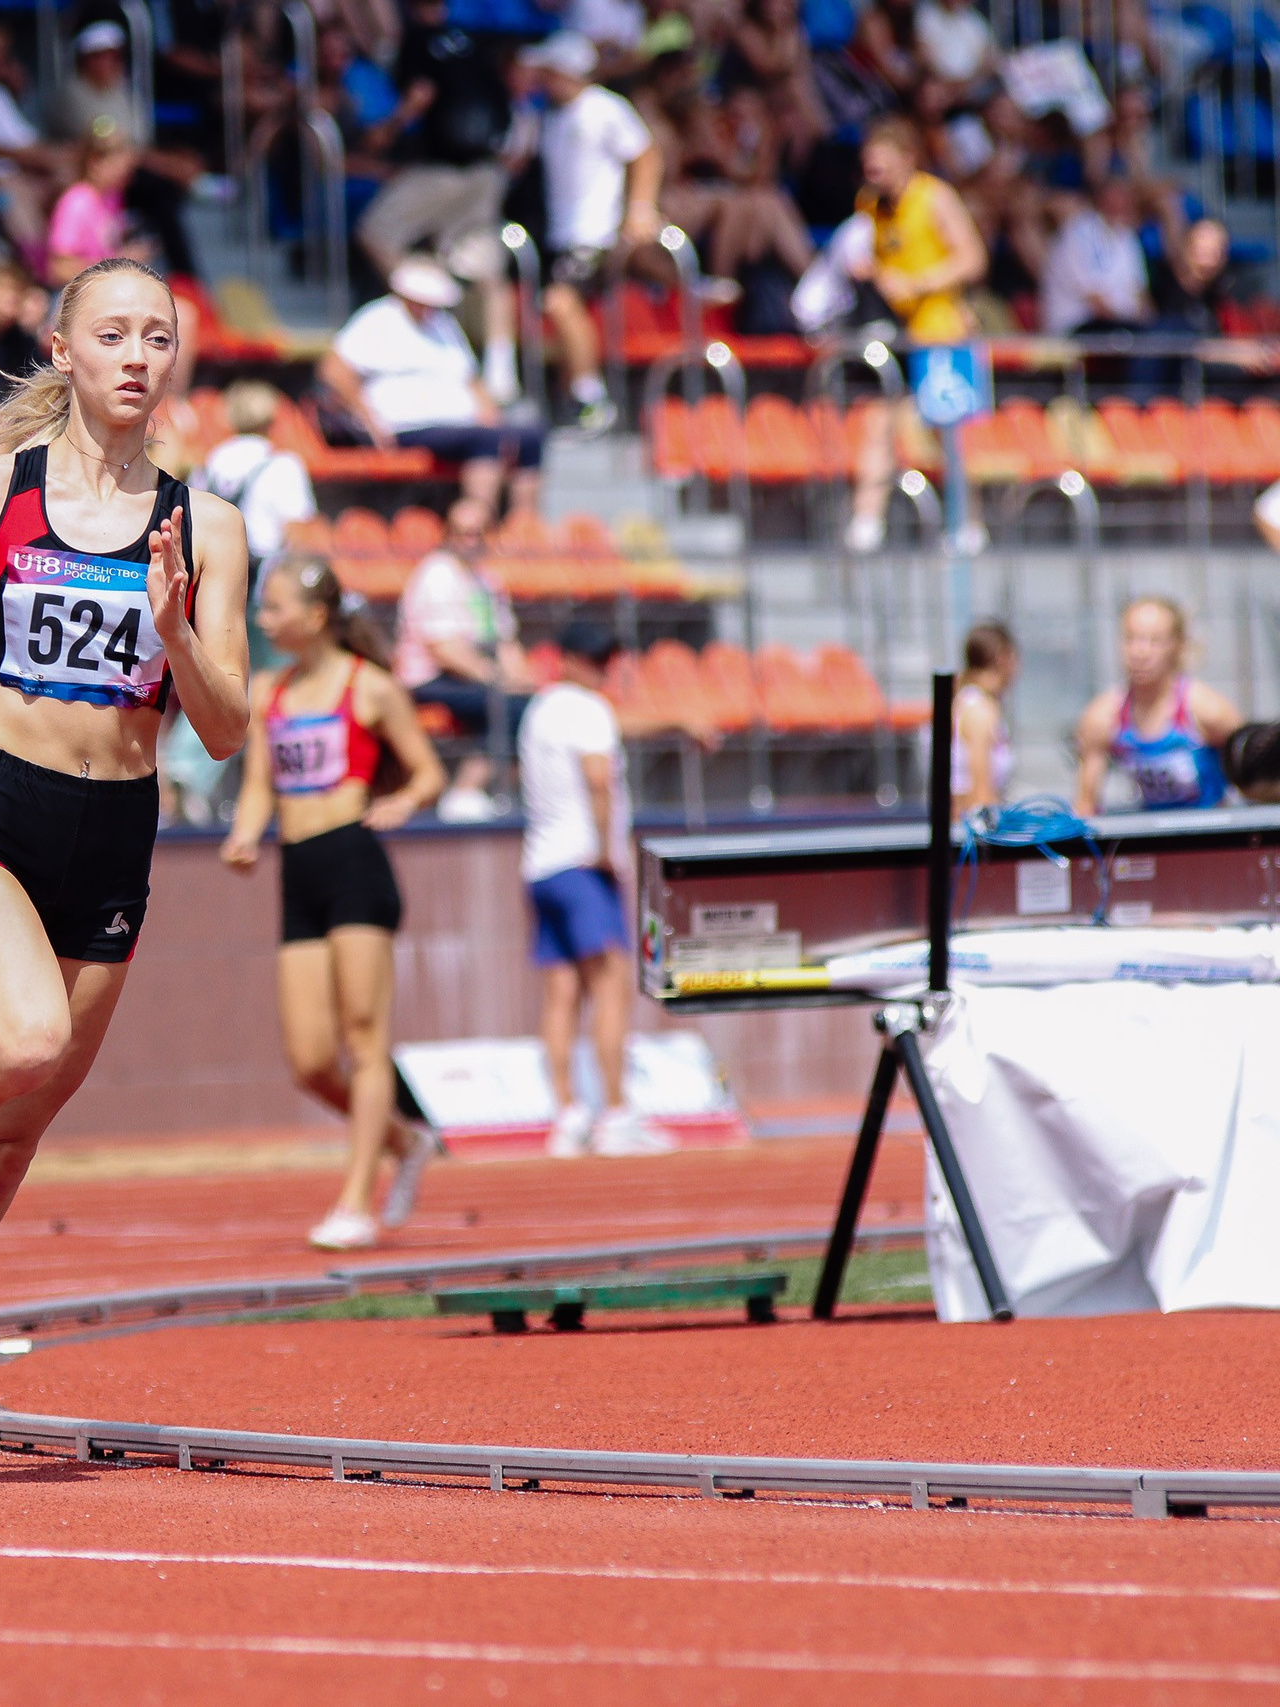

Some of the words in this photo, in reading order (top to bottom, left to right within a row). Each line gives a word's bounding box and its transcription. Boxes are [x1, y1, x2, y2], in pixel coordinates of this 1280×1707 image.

[14, 552, 61, 575] U18
[64, 561, 139, 579] ПЕРВЕНСТВО
[63, 570, 111, 584] РОССИИ
[28, 592, 142, 677] 524
